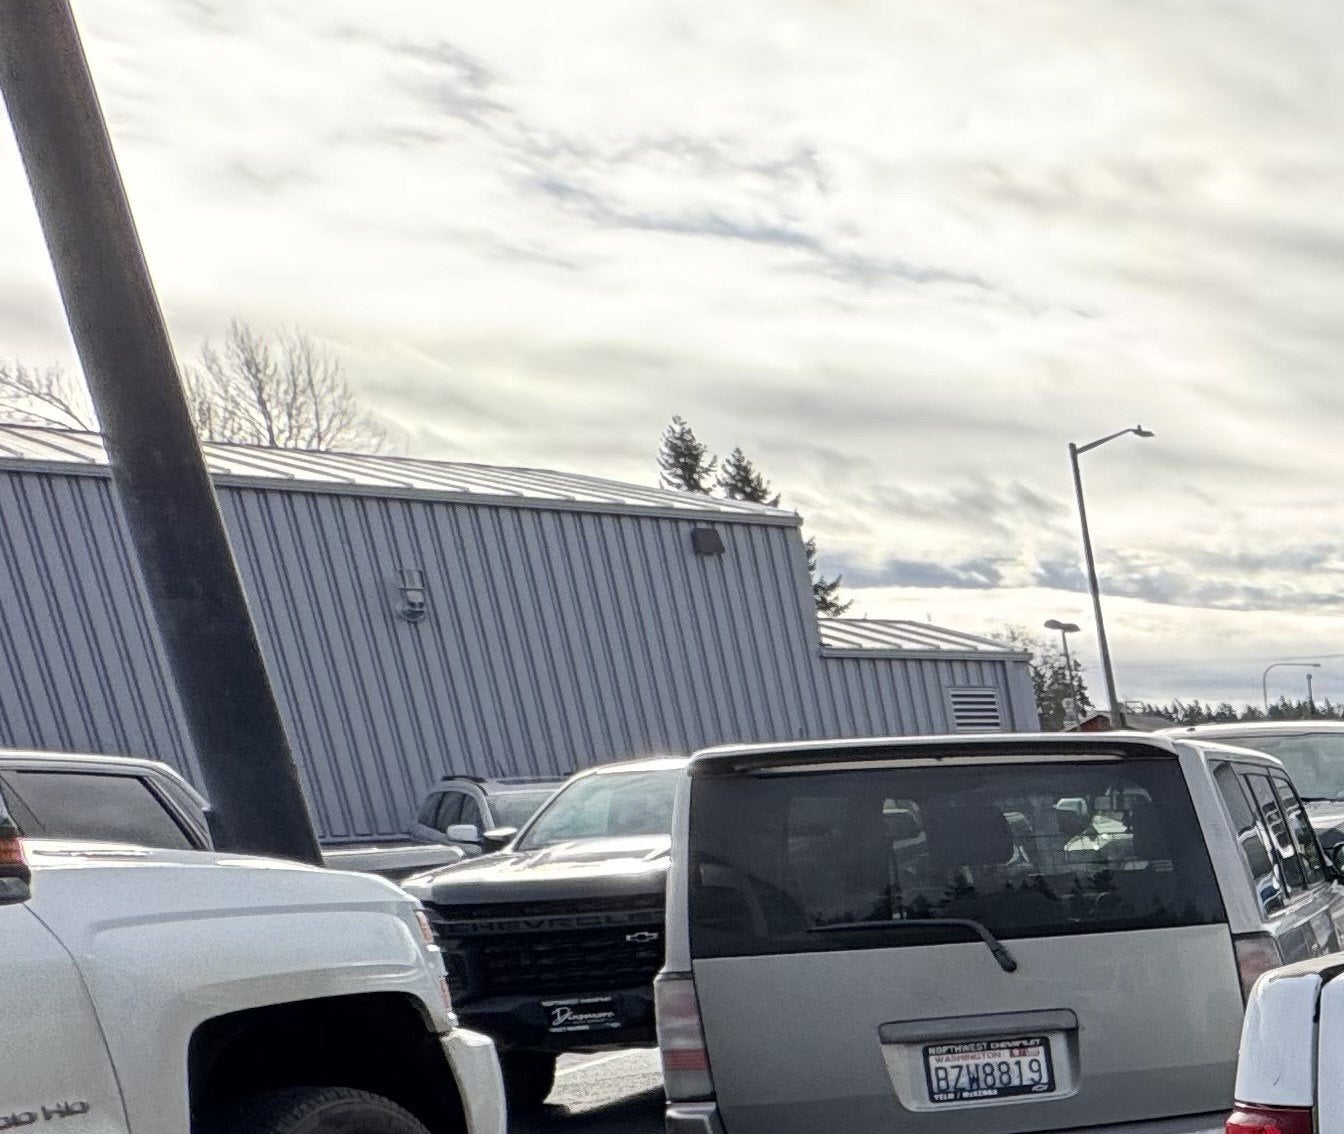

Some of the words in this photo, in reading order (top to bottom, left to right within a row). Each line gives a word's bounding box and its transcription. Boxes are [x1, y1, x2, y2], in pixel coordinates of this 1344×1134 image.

[929, 1043, 987, 1055] NORTHWEST
[935, 1051, 1002, 1063] WASHINGTON
[935, 1058, 1043, 1091] BZW8819
